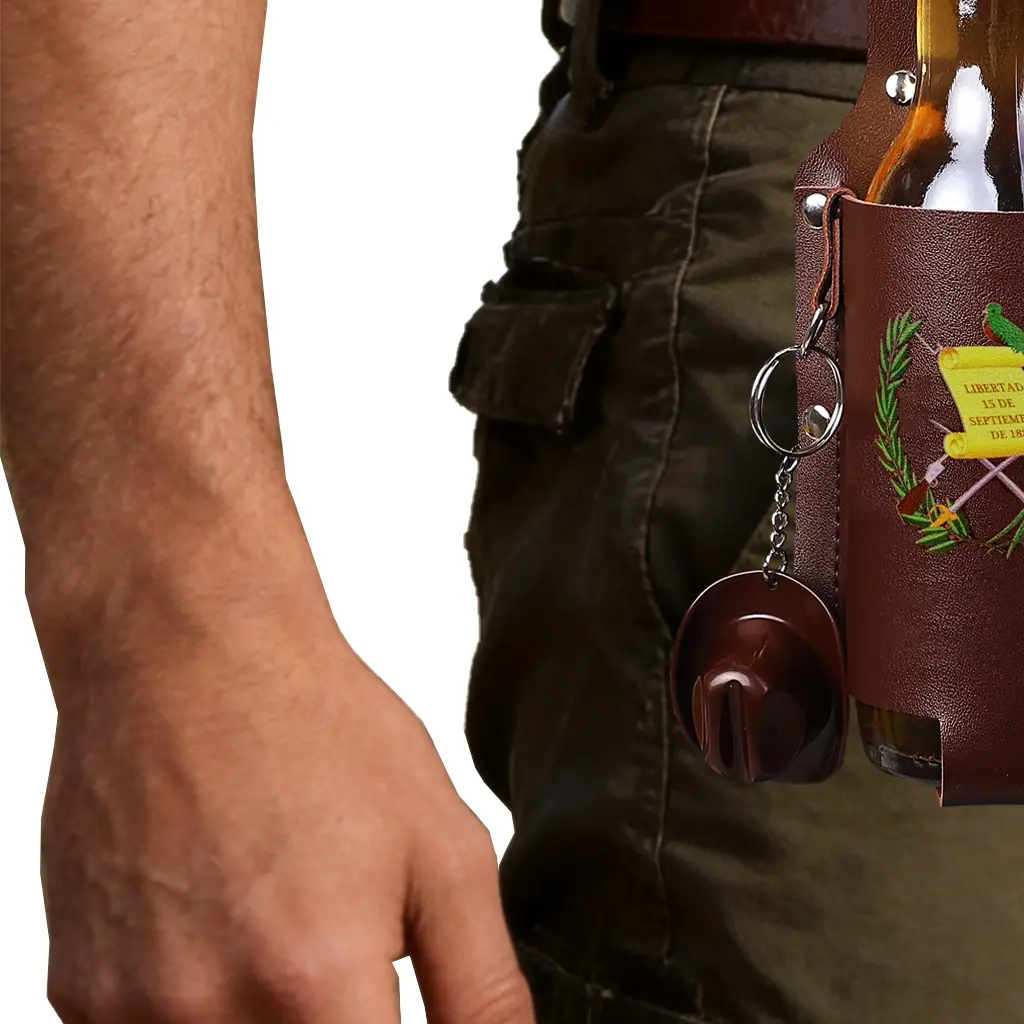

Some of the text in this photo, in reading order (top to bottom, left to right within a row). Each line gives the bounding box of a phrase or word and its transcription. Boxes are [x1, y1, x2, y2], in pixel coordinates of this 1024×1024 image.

[963, 382, 1024, 394] LIBERTAD
[982, 398, 1016, 409] 15 DE
[990, 430, 1008, 440] DE
